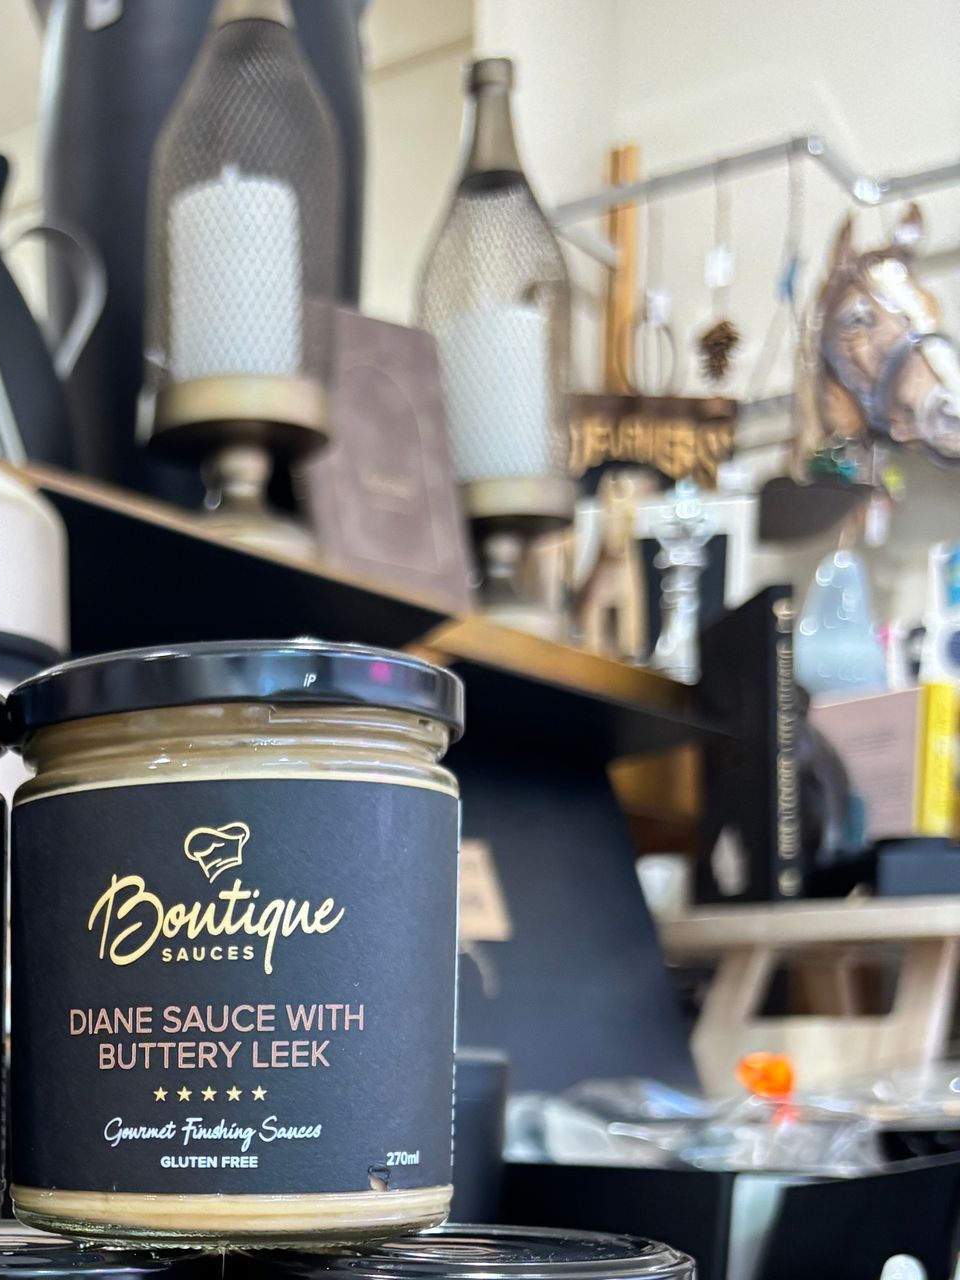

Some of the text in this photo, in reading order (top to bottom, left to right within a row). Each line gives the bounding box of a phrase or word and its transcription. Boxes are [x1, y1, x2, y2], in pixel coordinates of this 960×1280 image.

[89, 874, 345, 974] Boutique
[162, 946, 254, 961] SAUCES
[71, 1004, 364, 1034] DIANE SAUCE WITH
[100, 1040, 330, 1069] BUTTERY LEEK
[104, 1115, 322, 1152] Gourmet Finishing Sauces
[161, 1156, 258, 1168] GLUTEN FREE
[387, 1151, 419, 1165] 270ml
